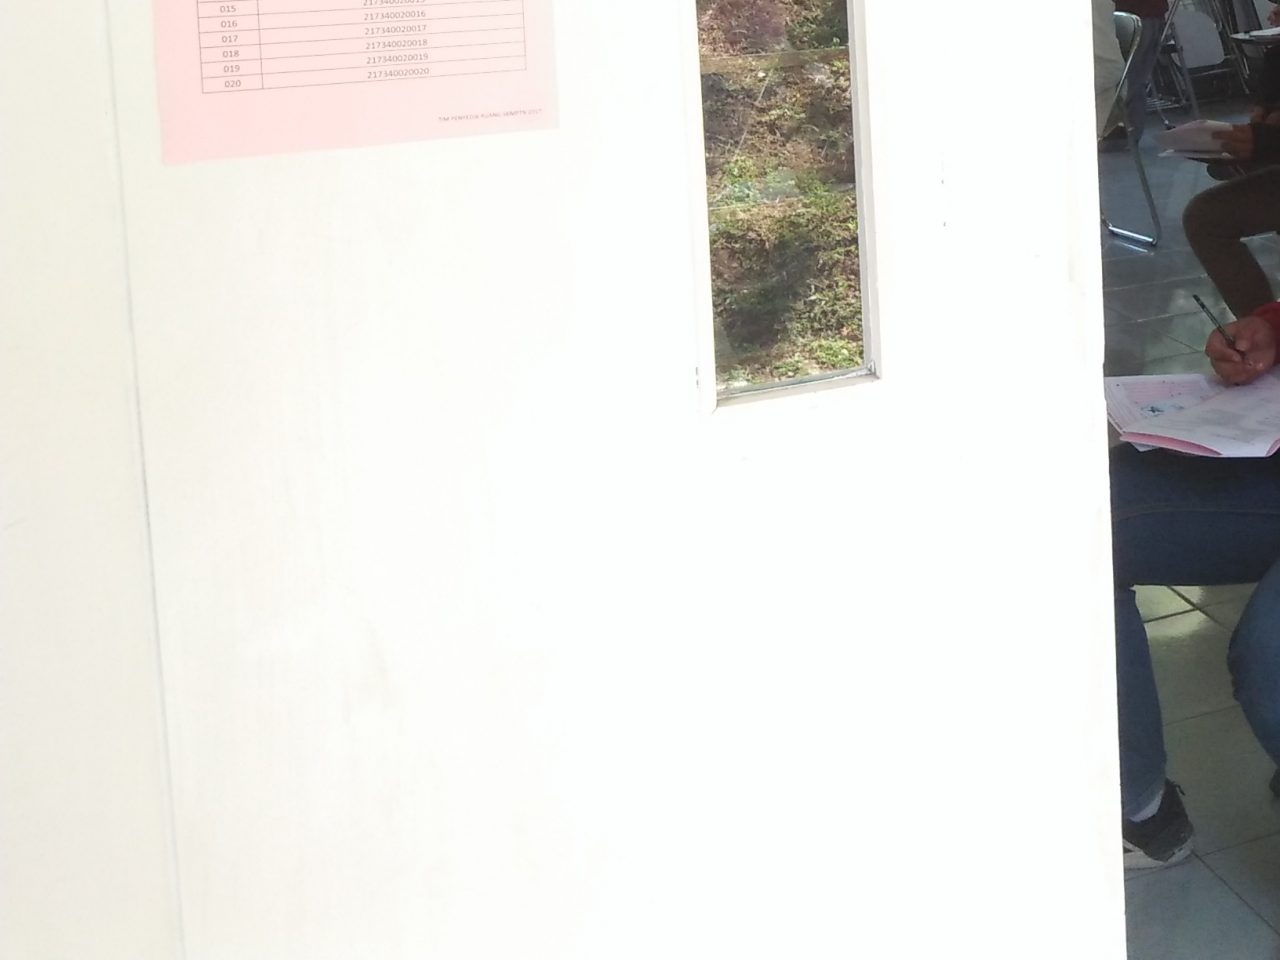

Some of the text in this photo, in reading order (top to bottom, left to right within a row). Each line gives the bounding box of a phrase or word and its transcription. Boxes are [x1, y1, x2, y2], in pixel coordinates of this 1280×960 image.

[219, 4, 236, 13] 015
[220, 19, 237, 28] 016
[221, 34, 238, 43] 017
[222, 49, 239, 58] 018
[223, 64, 240, 73] 019
[224, 79, 241, 88] 020
